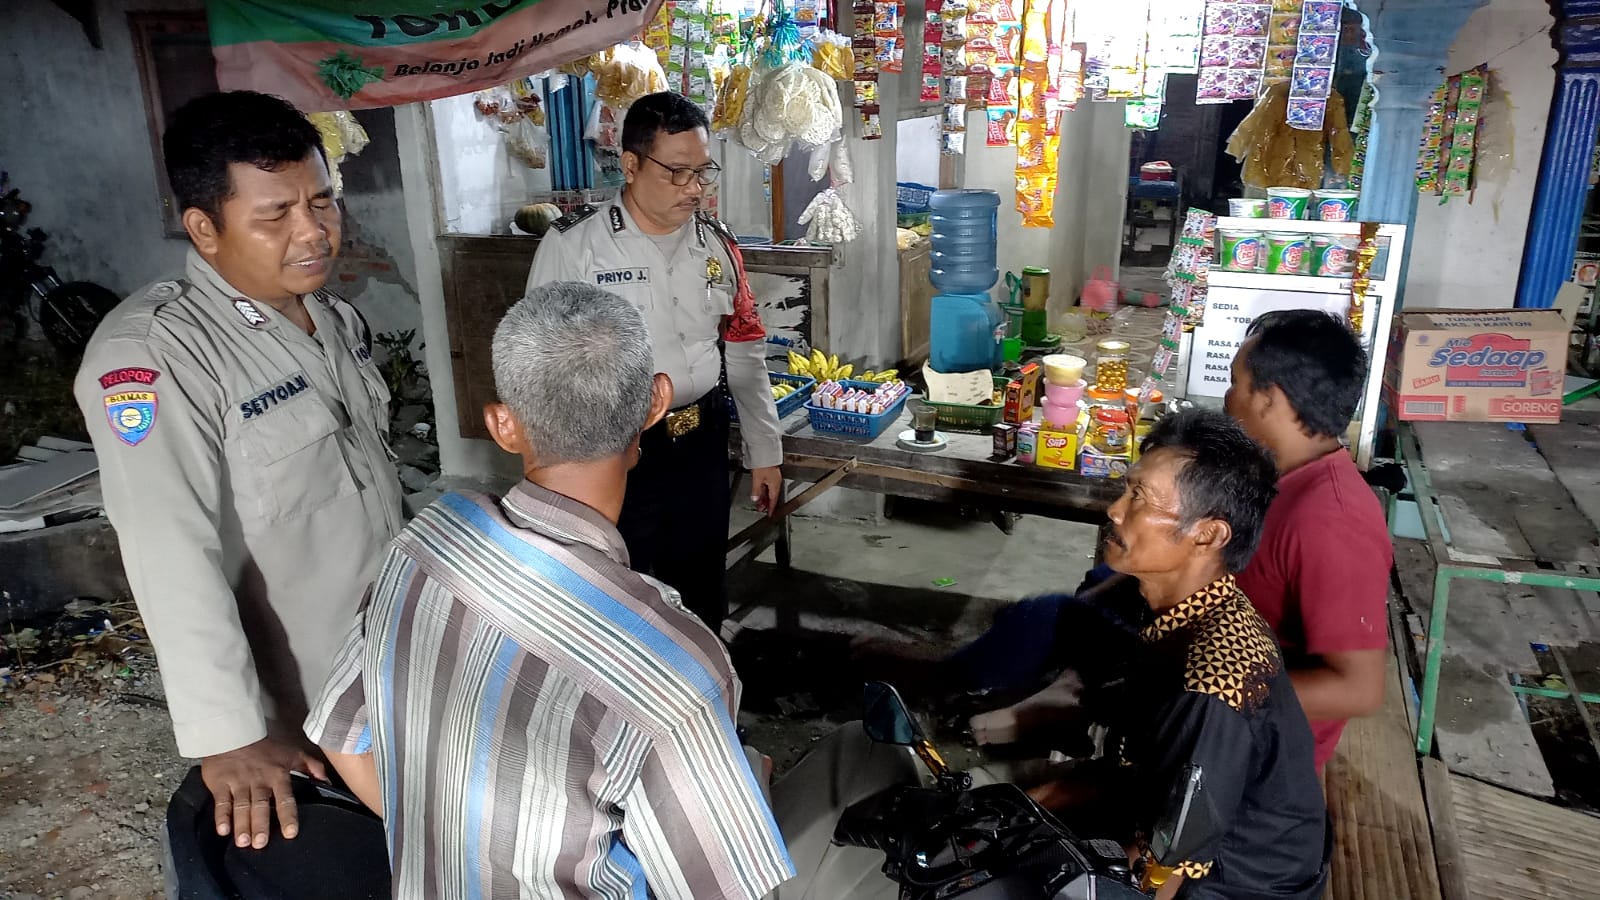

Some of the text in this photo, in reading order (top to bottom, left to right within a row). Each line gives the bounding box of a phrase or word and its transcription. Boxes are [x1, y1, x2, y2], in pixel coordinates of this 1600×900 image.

[393, 58, 479, 76] Belanja
[484, 39, 525, 67] Jadi
[596, 270, 647, 284] PRIYO J.
[1233, 316, 1252, 324] TOB
[1208, 339, 1232, 348] RASA
[1206, 351, 1230, 360] RASA
[1429, 346, 1546, 370] Sedaap
[1205, 363, 1228, 371] RASA
[103, 370, 153, 388] PELOPOR
[1203, 375, 1228, 383] RASA
[110, 393, 148, 403] BINMAS
[1502, 402, 1558, 413] GORENG
